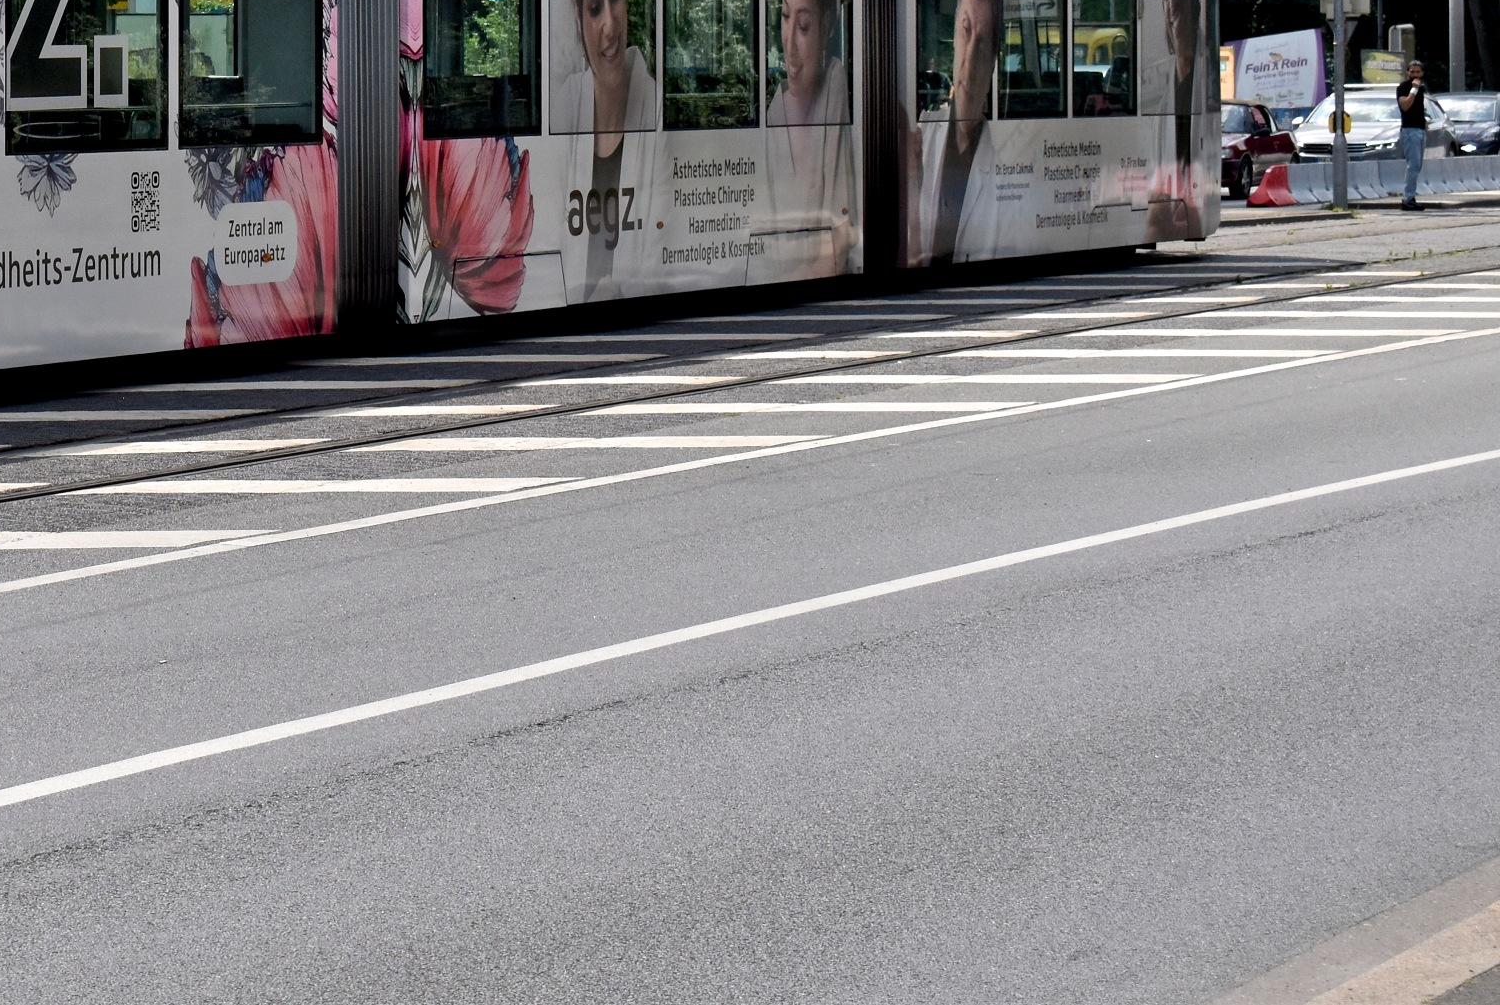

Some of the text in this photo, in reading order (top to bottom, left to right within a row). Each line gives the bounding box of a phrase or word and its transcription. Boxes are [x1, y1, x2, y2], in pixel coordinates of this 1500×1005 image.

[1281, 57, 1308, 69] Rein
[672, 157, 756, 179] Ästhetische Medizin
[674, 184, 755, 208] Plastische Chirurgie
[228, 217, 284, 237] Zentral am
[568, 187, 642, 250] aegz.
[689, 213, 741, 234] Haarmedizin
[224, 243, 286, 268] Europaplatz
[662, 237, 766, 265] Dermatologie & Kosmetik
